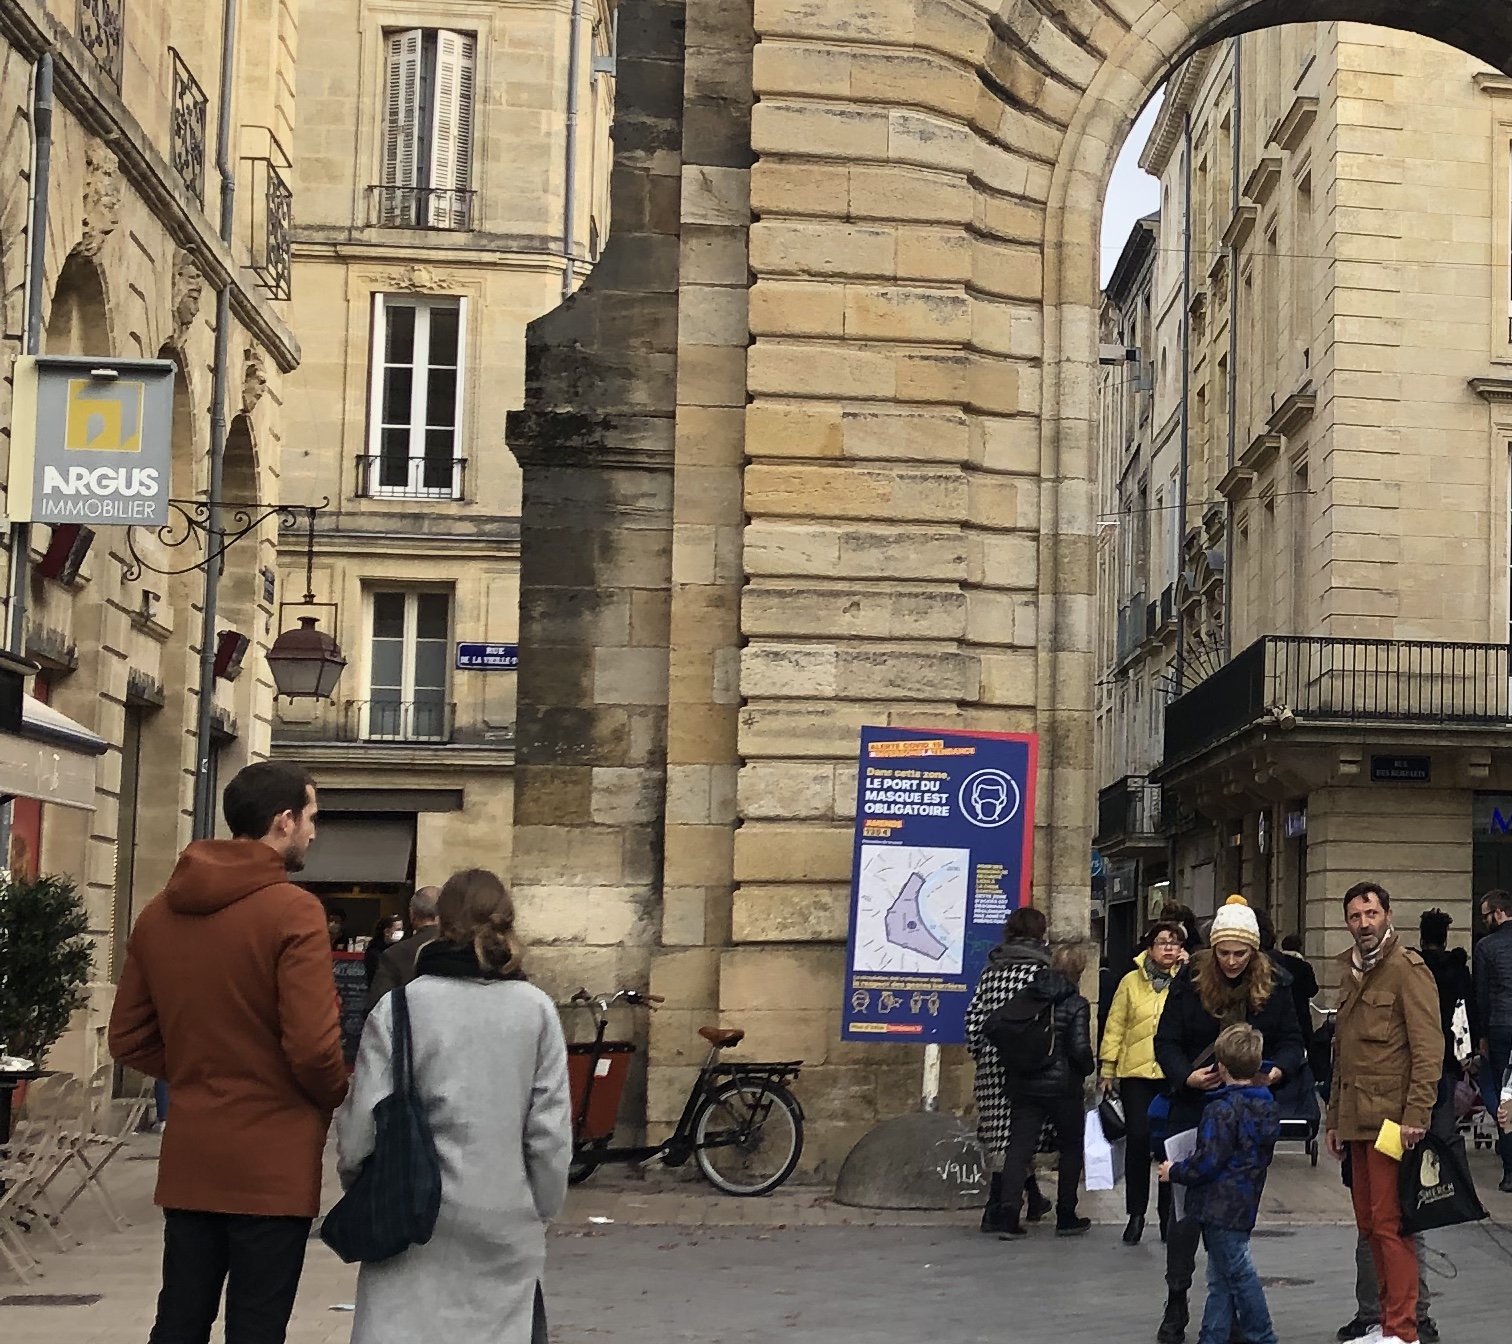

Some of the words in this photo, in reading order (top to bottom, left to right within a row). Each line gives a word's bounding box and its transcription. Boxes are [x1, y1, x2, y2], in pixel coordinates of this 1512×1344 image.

[42, 465, 159, 497] ARGUS
[41, 498, 156, 518] IMMOBILIER
[867, 767, 892, 776] Dans
[895, 769, 921, 778] cette
[866, 778, 882, 788] LE
[883, 779, 917, 790] PORT
[921, 781, 940, 791] DU
[865, 791, 921, 802] MASQUE
[924, 793, 949, 803] EST
[865, 803, 950, 816] OBLIGATOIRE
